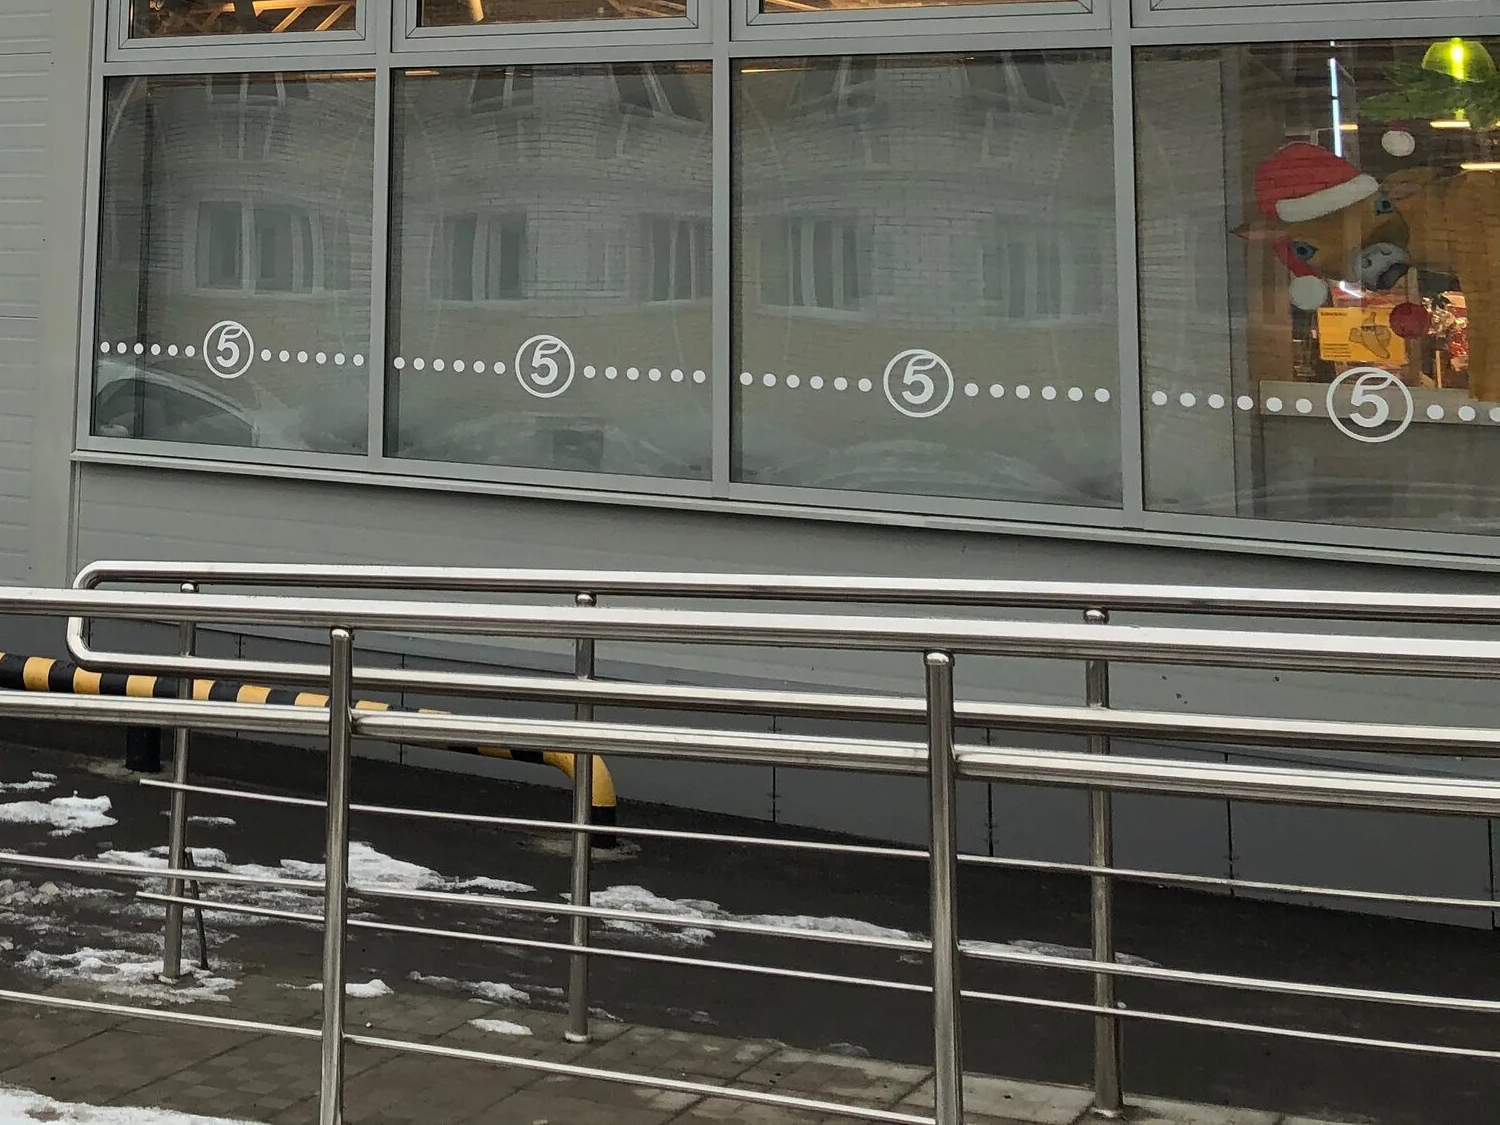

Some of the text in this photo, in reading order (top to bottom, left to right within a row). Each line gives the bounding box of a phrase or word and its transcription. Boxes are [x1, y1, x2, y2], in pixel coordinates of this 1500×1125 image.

[216, 325, 243, 368] 5
[530, 340, 562, 386] 5
[901, 354, 938, 405] 5
[1349, 373, 1395, 429] 5
